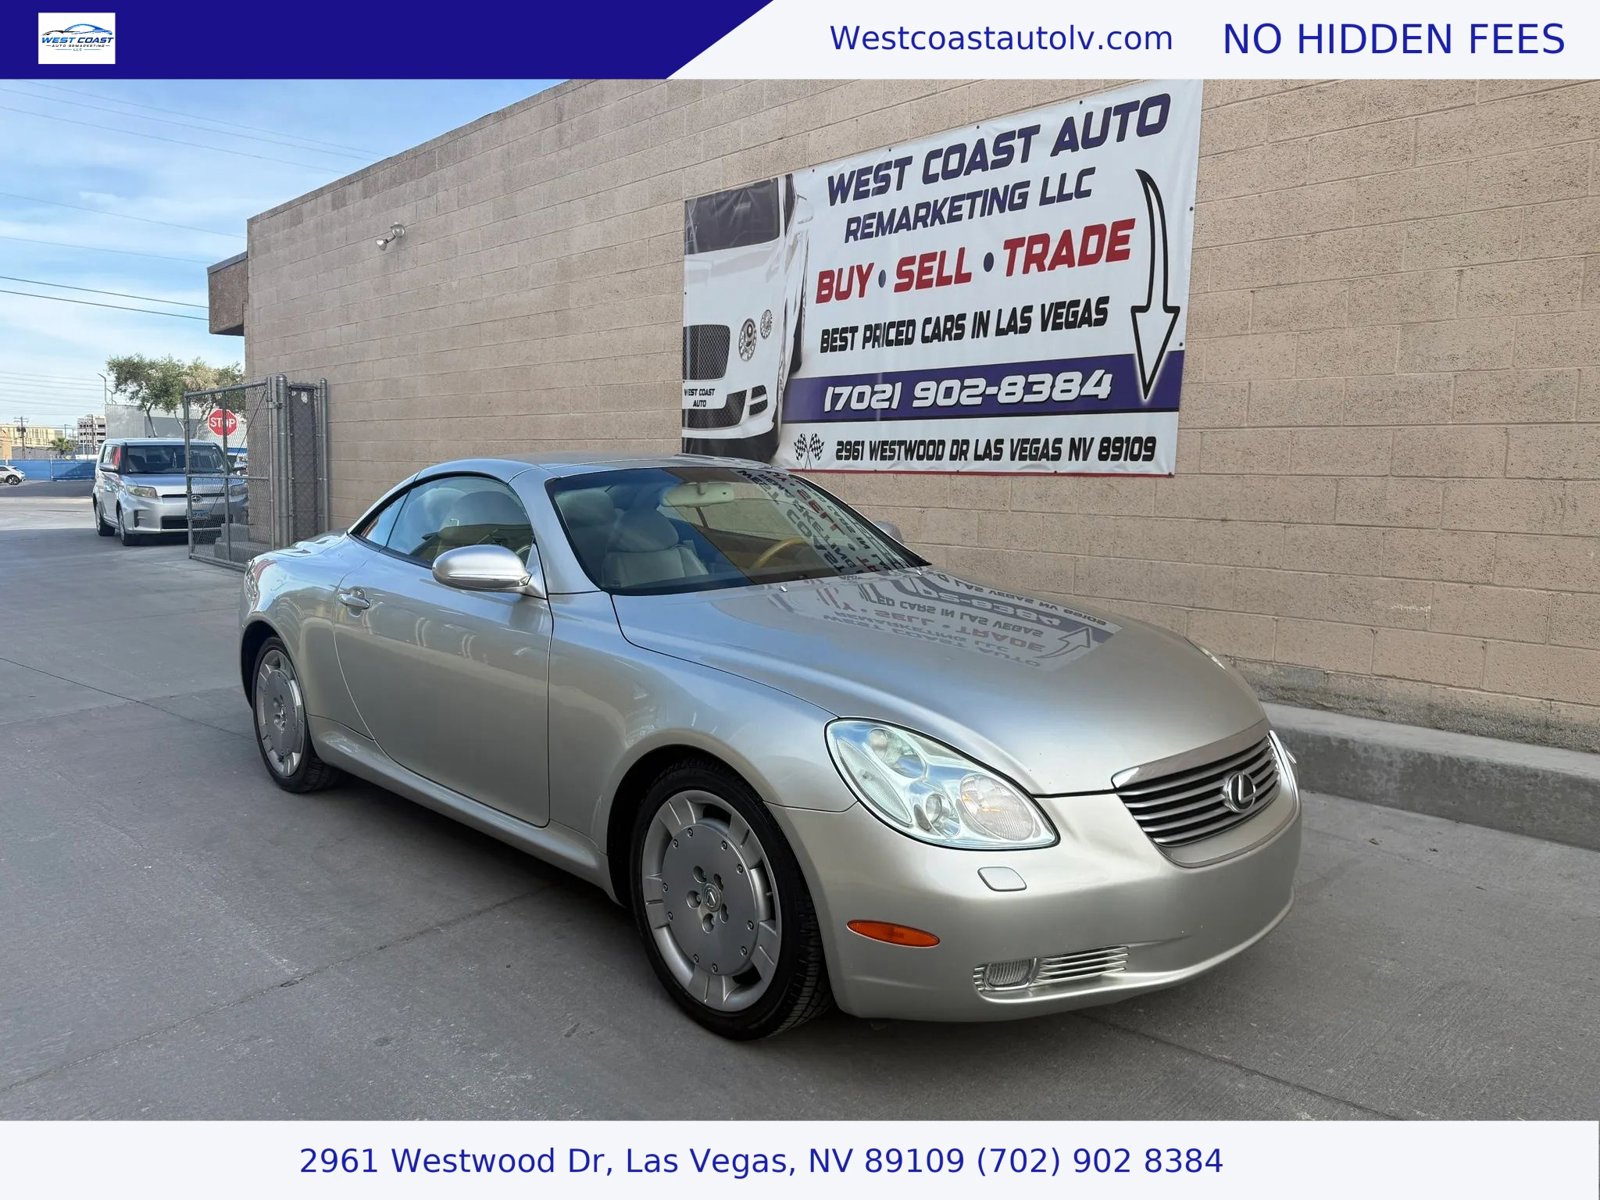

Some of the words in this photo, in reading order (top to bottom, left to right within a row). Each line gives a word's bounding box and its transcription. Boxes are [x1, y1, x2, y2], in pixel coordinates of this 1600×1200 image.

[827, 156, 913, 207] WEST
[921, 124, 1041, 185] COAST
[1049, 93, 1172, 157] AUTO
[844, 180, 1031, 243] REMARKETING
[1038, 166, 1096, 218] LLC
[815, 262, 875, 304] BUY
[893, 246, 972, 293] SELL
[1002, 217, 1136, 277] TRADE
[819, 325, 859, 354] BEST
[861, 318, 917, 350] PRICED
[920, 312, 967, 344] CARS
[971, 309, 991, 339] IN
[994, 304, 1034, 337] LAS
[1039, 295, 1111, 331] VEGAS
[684, 388, 699, 396] WEST
[699, 388, 716, 396] COAST
[911, 369, 1114, 409] 902-8384
[835, 439, 865, 462] 2961
[868, 438, 945, 462] WESTWOOD
[949, 438, 970, 461] DR
[973, 438, 1004, 461] LAS
[1009, 437, 1063, 461] VEGAS
[1068, 437, 1096, 461] NV
[1097, 436, 1158, 462] 89109
